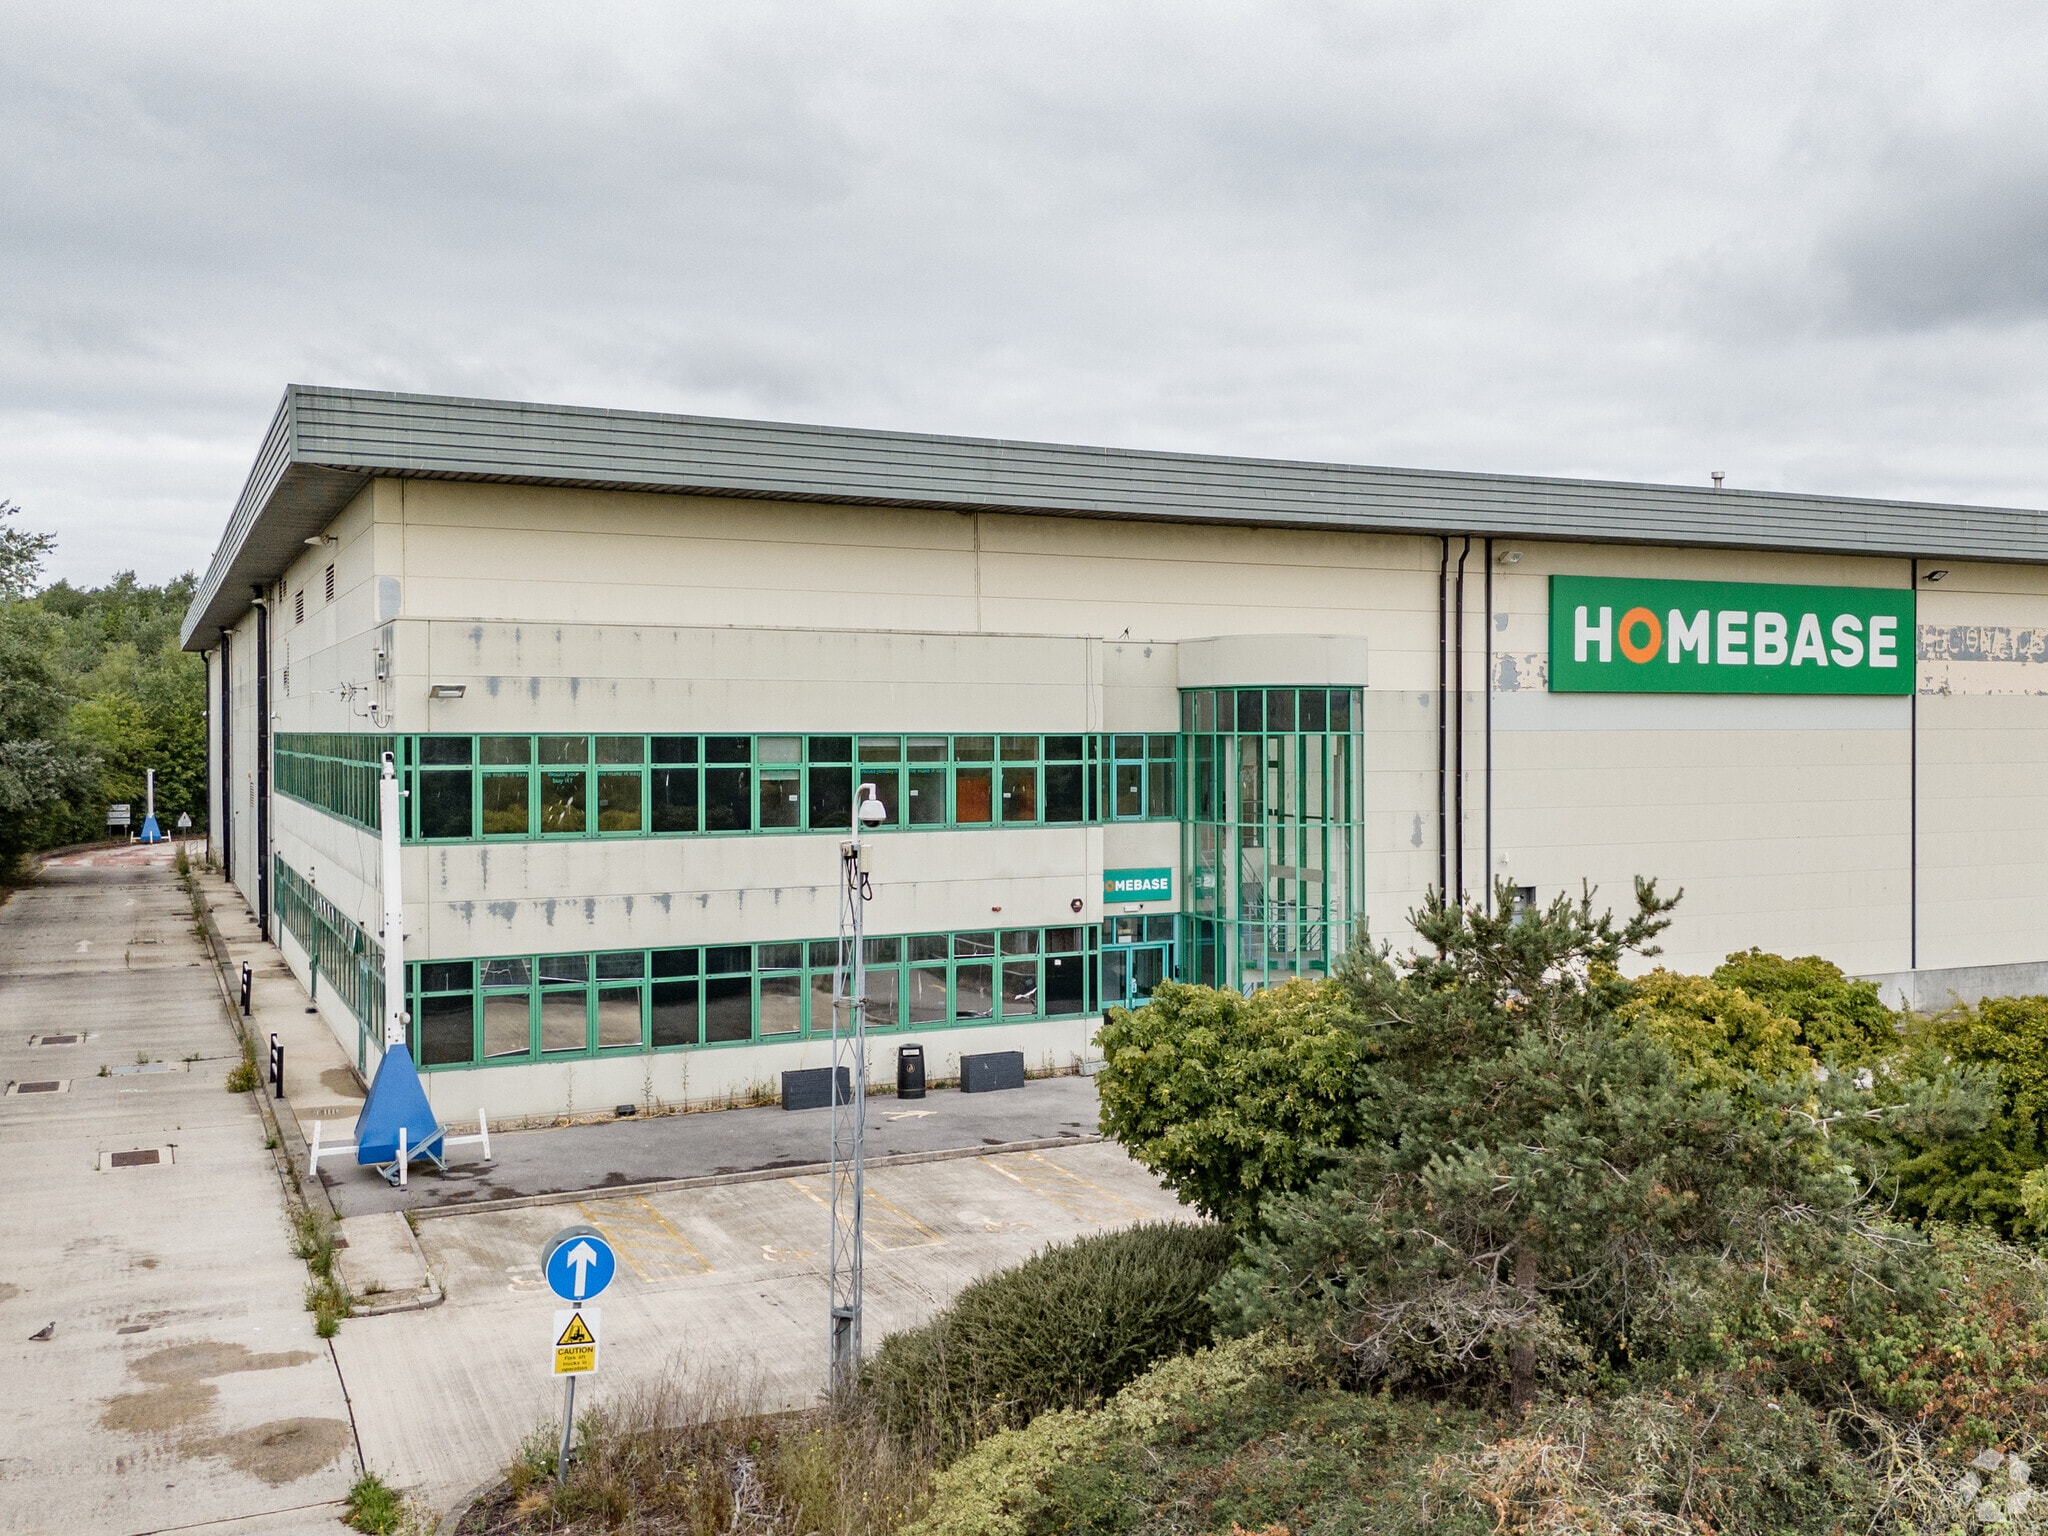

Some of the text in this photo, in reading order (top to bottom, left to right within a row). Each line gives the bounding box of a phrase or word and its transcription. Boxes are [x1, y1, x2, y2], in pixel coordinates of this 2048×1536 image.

[1574, 605, 1897, 668] HOMEBASE
[1104, 877, 1168, 893] OMEBASE
[557, 1346, 594, 1355] CAUTION
